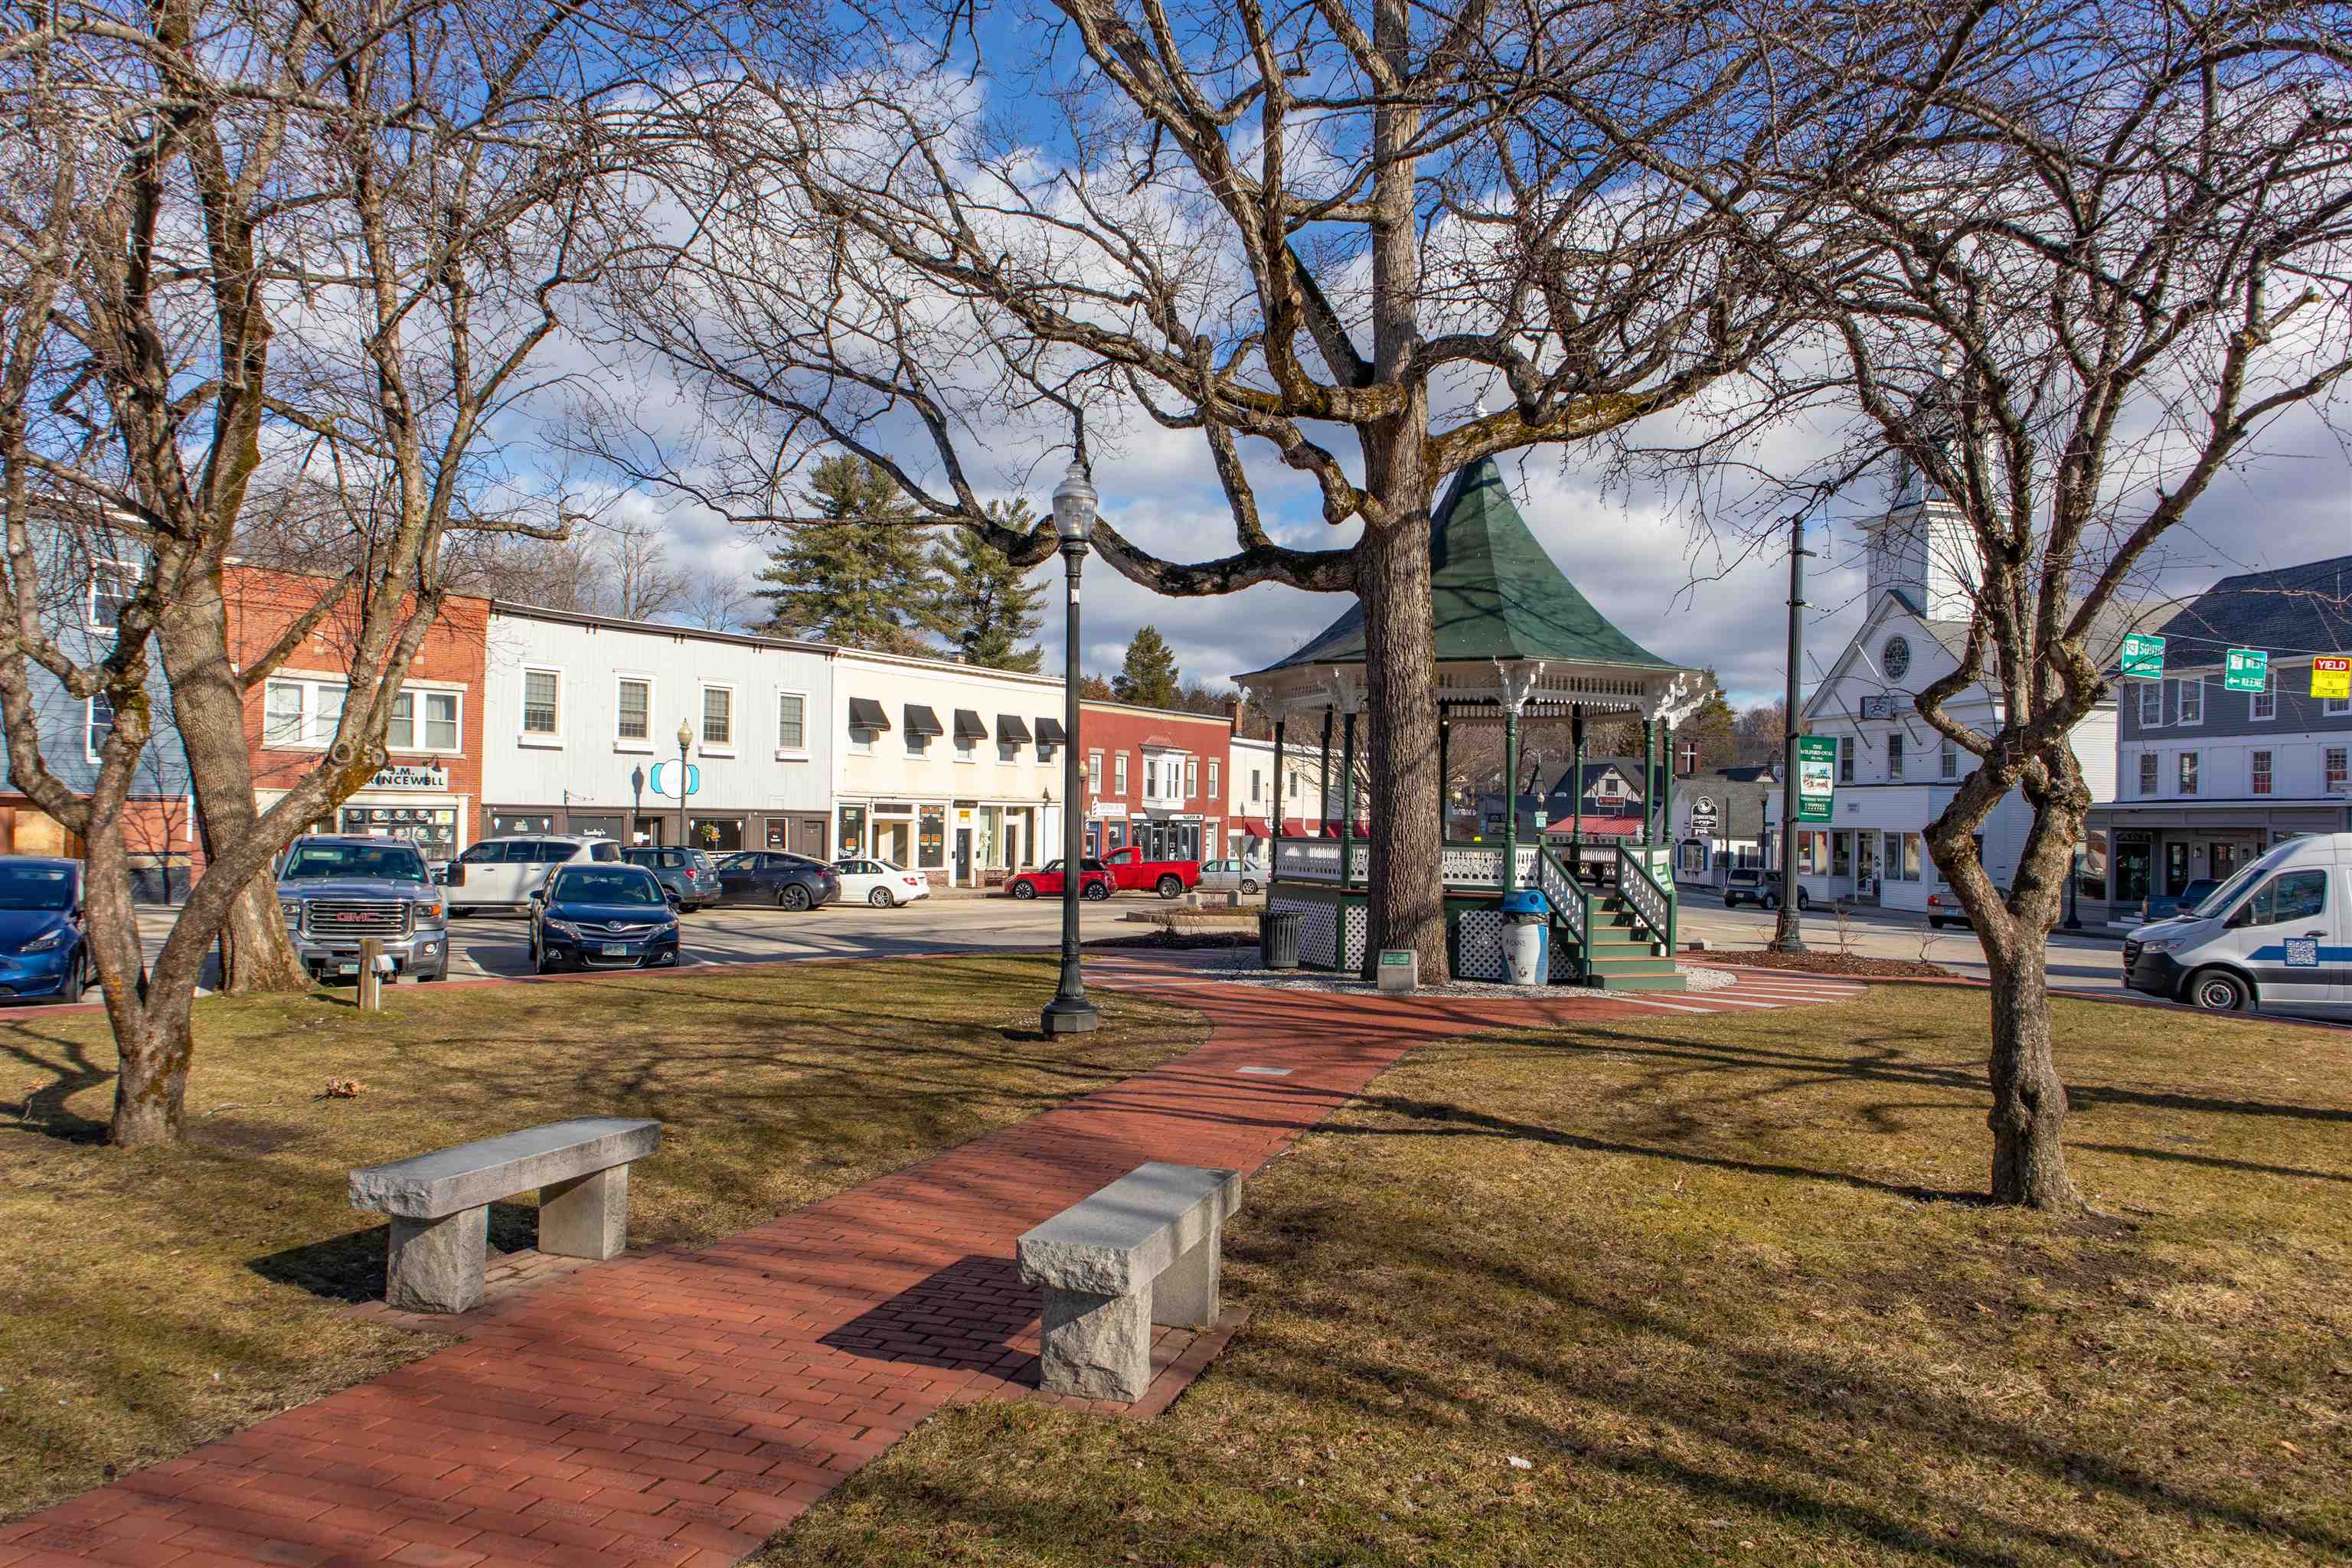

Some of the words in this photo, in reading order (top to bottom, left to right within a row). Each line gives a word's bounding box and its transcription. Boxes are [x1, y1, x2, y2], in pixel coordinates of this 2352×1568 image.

[2318, 660, 2347, 670] YIELD
[2242, 677, 2263, 688] KEENE
[337, 912, 380, 922] GMC
